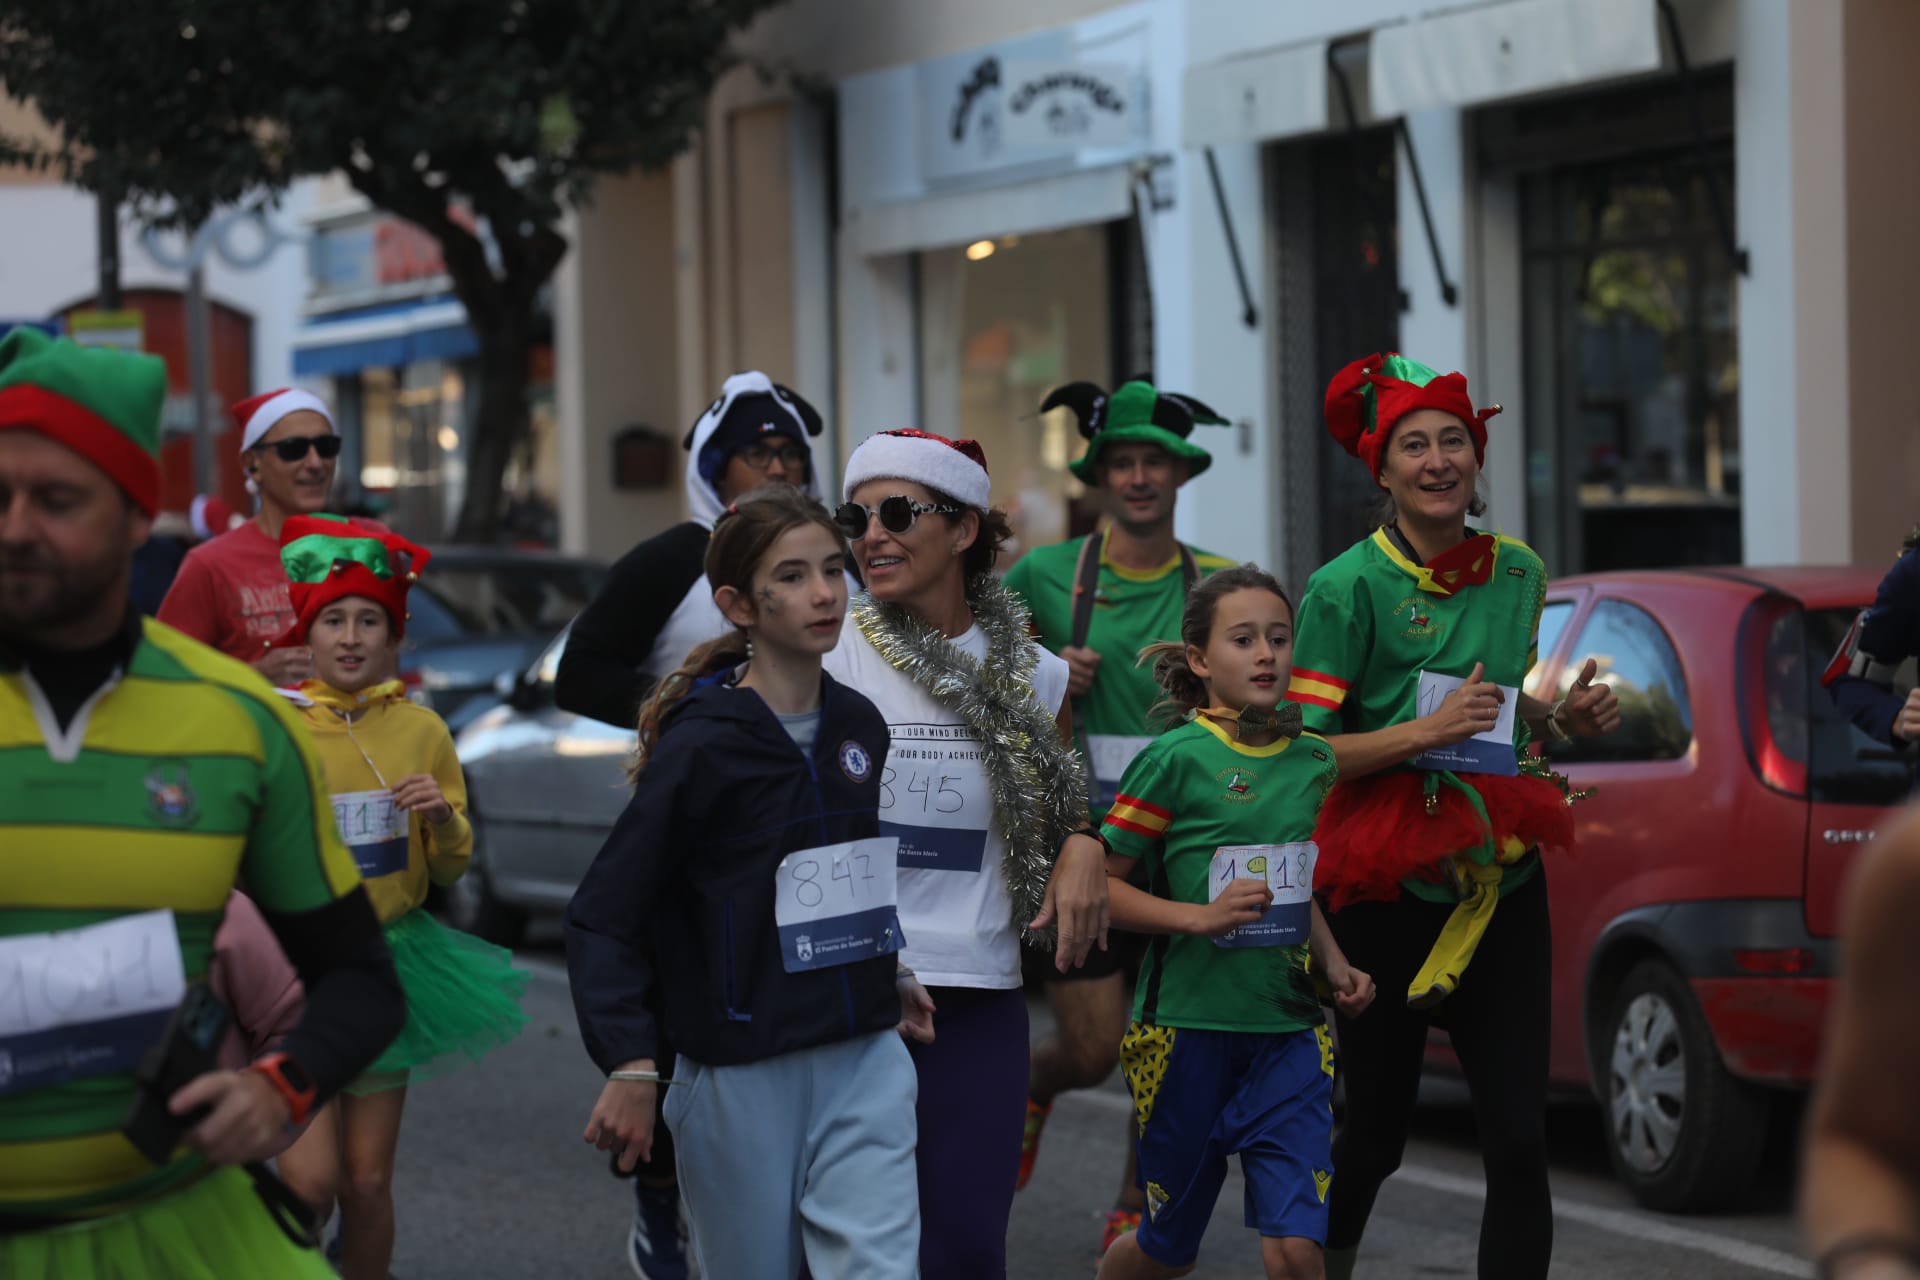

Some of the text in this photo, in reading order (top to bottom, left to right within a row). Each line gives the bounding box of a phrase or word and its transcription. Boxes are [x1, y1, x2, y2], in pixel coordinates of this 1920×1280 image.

[903, 727, 925, 737] YOUR
[929, 728, 950, 737] MIND
[954, 728, 976, 738] BEL
[895, 749, 917, 759] YOUR
[921, 750, 944, 760] BODY
[879, 766, 964, 813] 845
[792, 854, 875, 908] 847
[1220, 852, 1308, 889] 1918
[822, 944, 840, 953] Puerto
[840, 942, 848, 950] de
